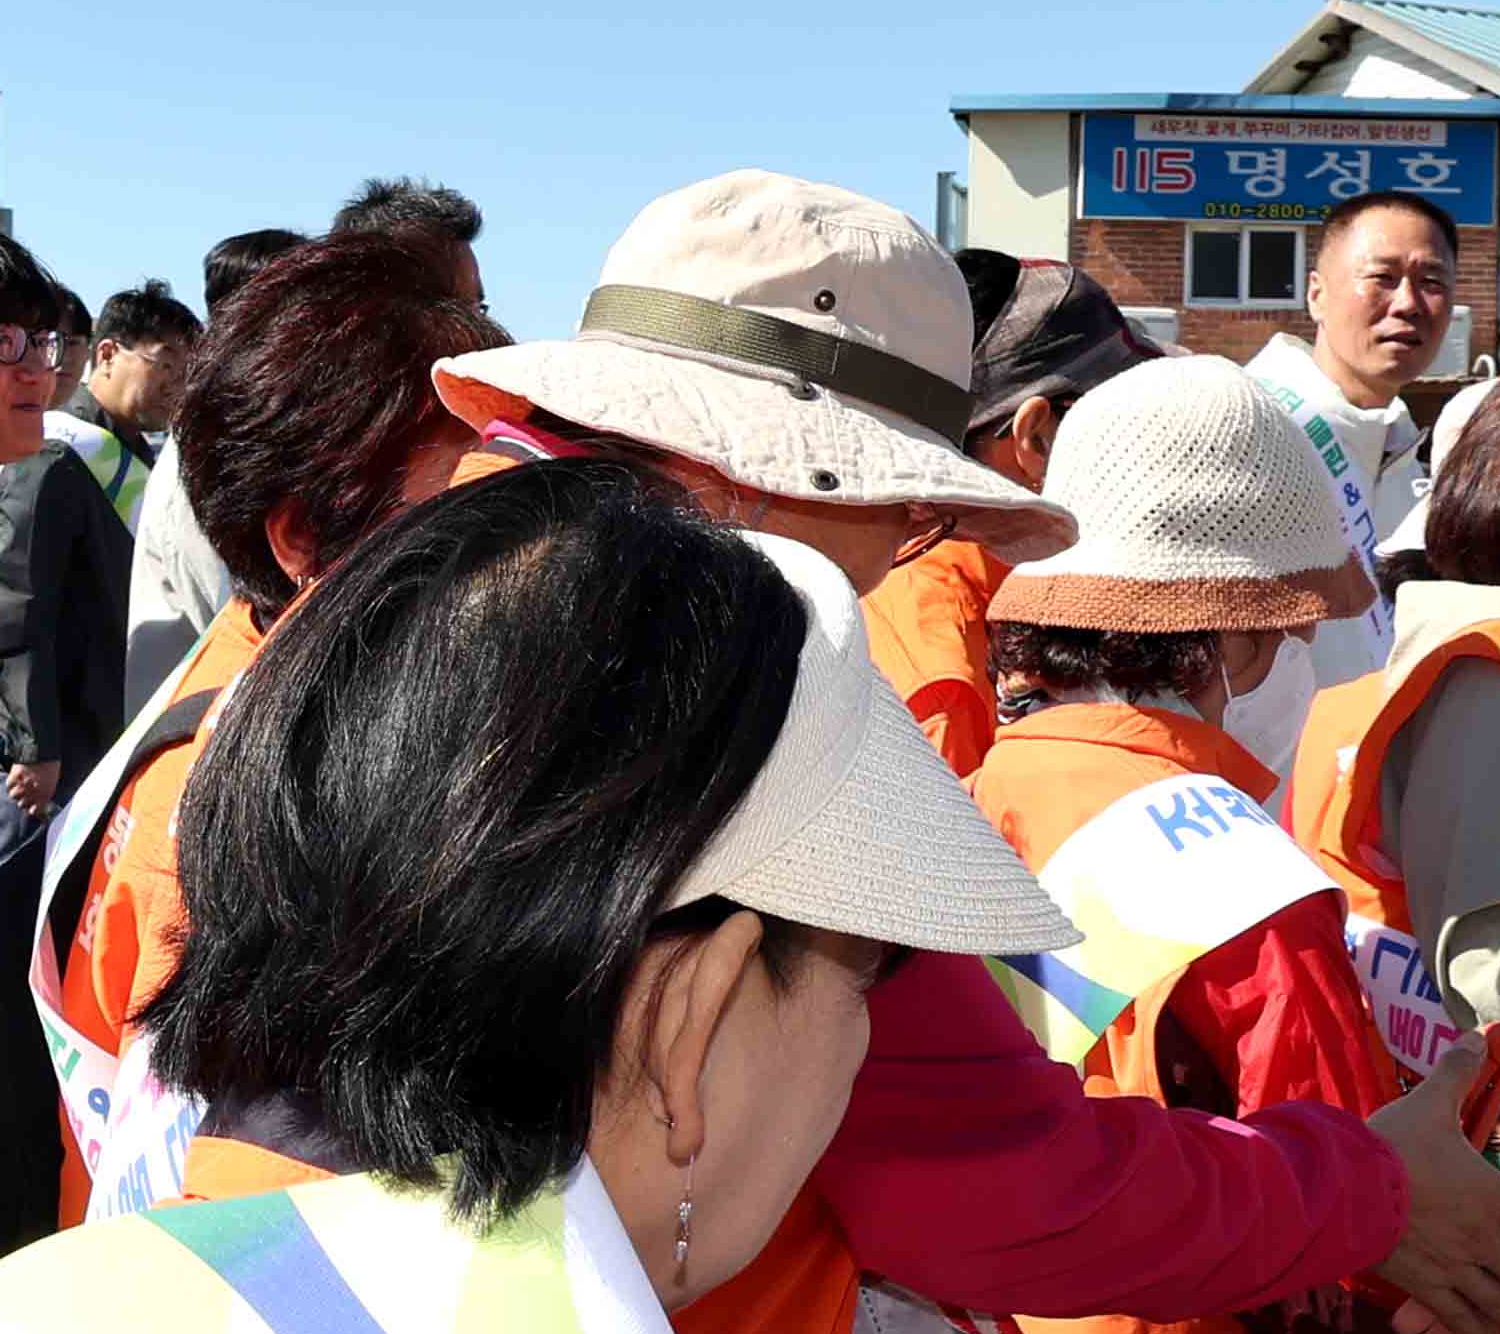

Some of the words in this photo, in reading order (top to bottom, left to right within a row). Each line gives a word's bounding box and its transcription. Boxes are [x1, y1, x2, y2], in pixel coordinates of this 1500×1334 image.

[1111, 146, 1198, 194] 115
[1224, 148, 1464, 200] 명성호
[1204, 202, 1332, 221] 010-2800-3
